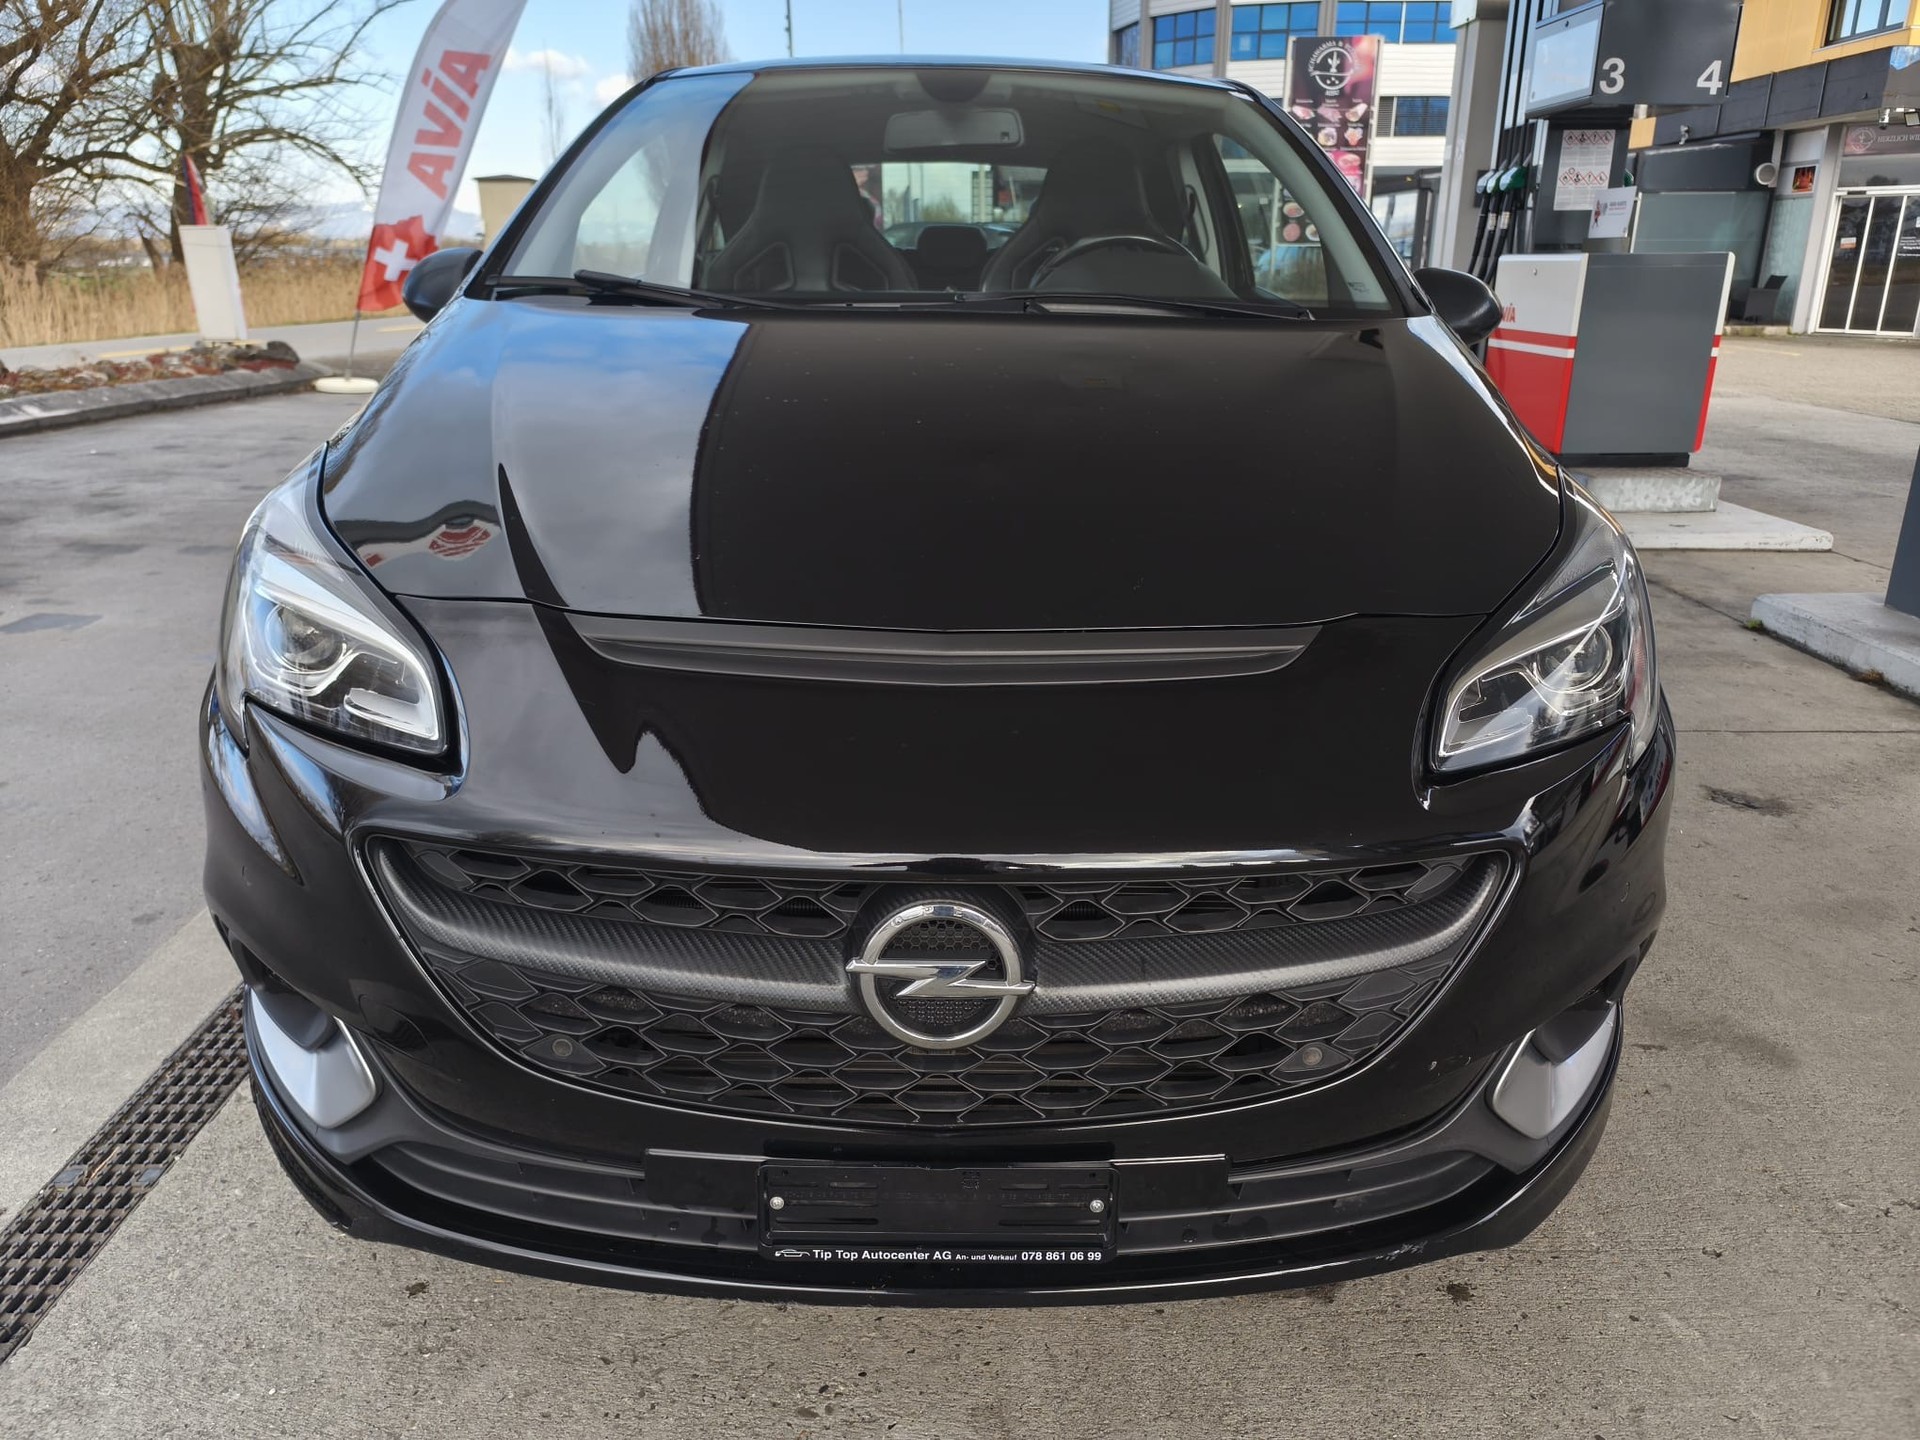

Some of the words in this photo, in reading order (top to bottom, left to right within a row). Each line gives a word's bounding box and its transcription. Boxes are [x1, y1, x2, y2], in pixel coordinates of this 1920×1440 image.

[1599, 57, 1626, 95] 3
[1695, 59, 1723, 96] 4
[812, 1250, 832, 1261] Tip
[836, 1250, 859, 1261] Top
[861, 1250, 930, 1260] Autocenter
[932, 1250, 952, 1260] AG
[955, 1253, 969, 1261] An-
[970, 1253, 986, 1261] und
[988, 1253, 1017, 1261] Verkauf
[1021, 1251, 1043, 1261] 078
[1045, 1251, 1066, 1261] 861
[1069, 1251, 1084, 1261] 06
[1087, 1251, 1102, 1261] 99
